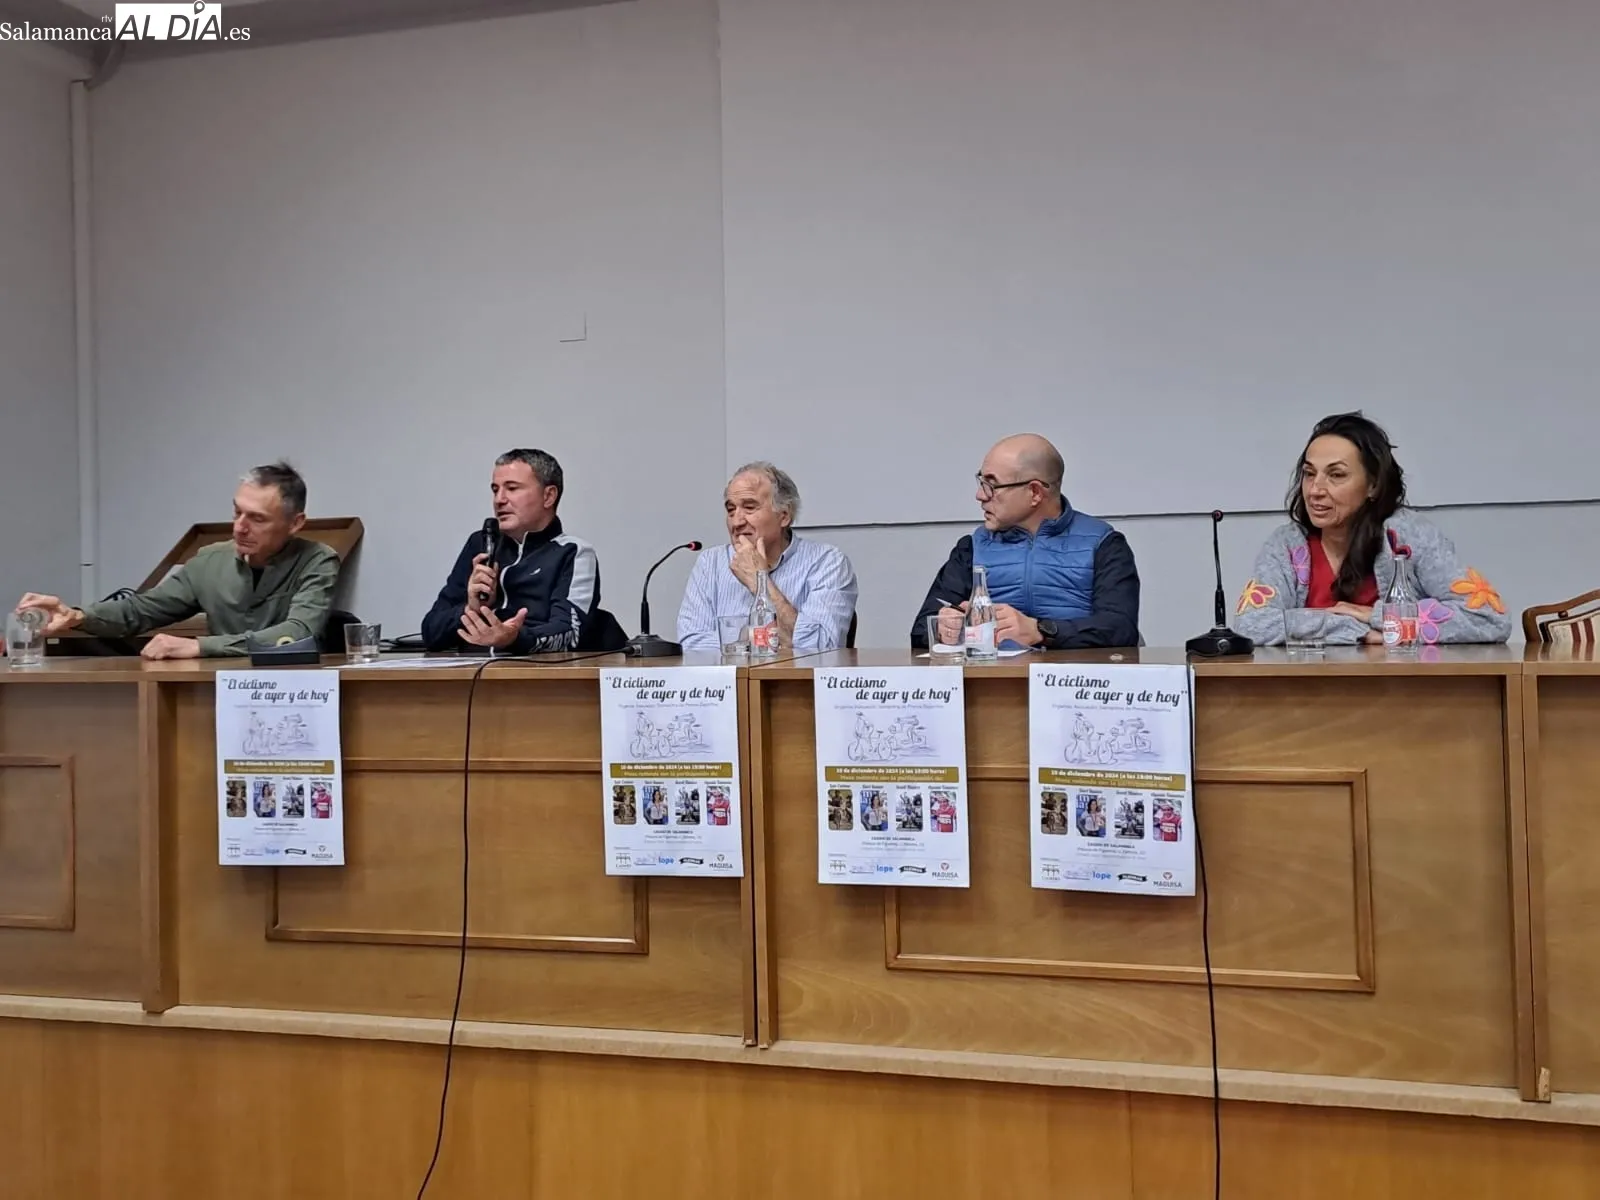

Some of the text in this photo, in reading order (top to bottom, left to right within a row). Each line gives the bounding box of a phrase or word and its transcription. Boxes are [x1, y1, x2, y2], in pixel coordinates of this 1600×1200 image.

[238, 679, 277, 690] ciclismo
[623, 678, 666, 688] ciclismo
[840, 677, 887, 688] ciclismo
[1058, 675, 1110, 688] ciclismo
[251, 690, 262, 700] de
[264, 692, 286, 703] ayer
[288, 692, 295, 703] y
[297, 690, 308, 700] de
[636, 689, 649, 699] de
[652, 690, 677, 703] ayer
[680, 690, 686, 702] y
[689, 688, 702, 698] de
[856, 690, 869, 700] de
[872, 691, 899, 703] ayer
[902, 691, 909, 703] y
[912, 689, 926, 700] de
[1075, 688, 1090, 700] de
[1094, 691, 1123, 704] ayer
[1126, 692, 1134, 705] y
[1138, 690, 1152, 701] de
